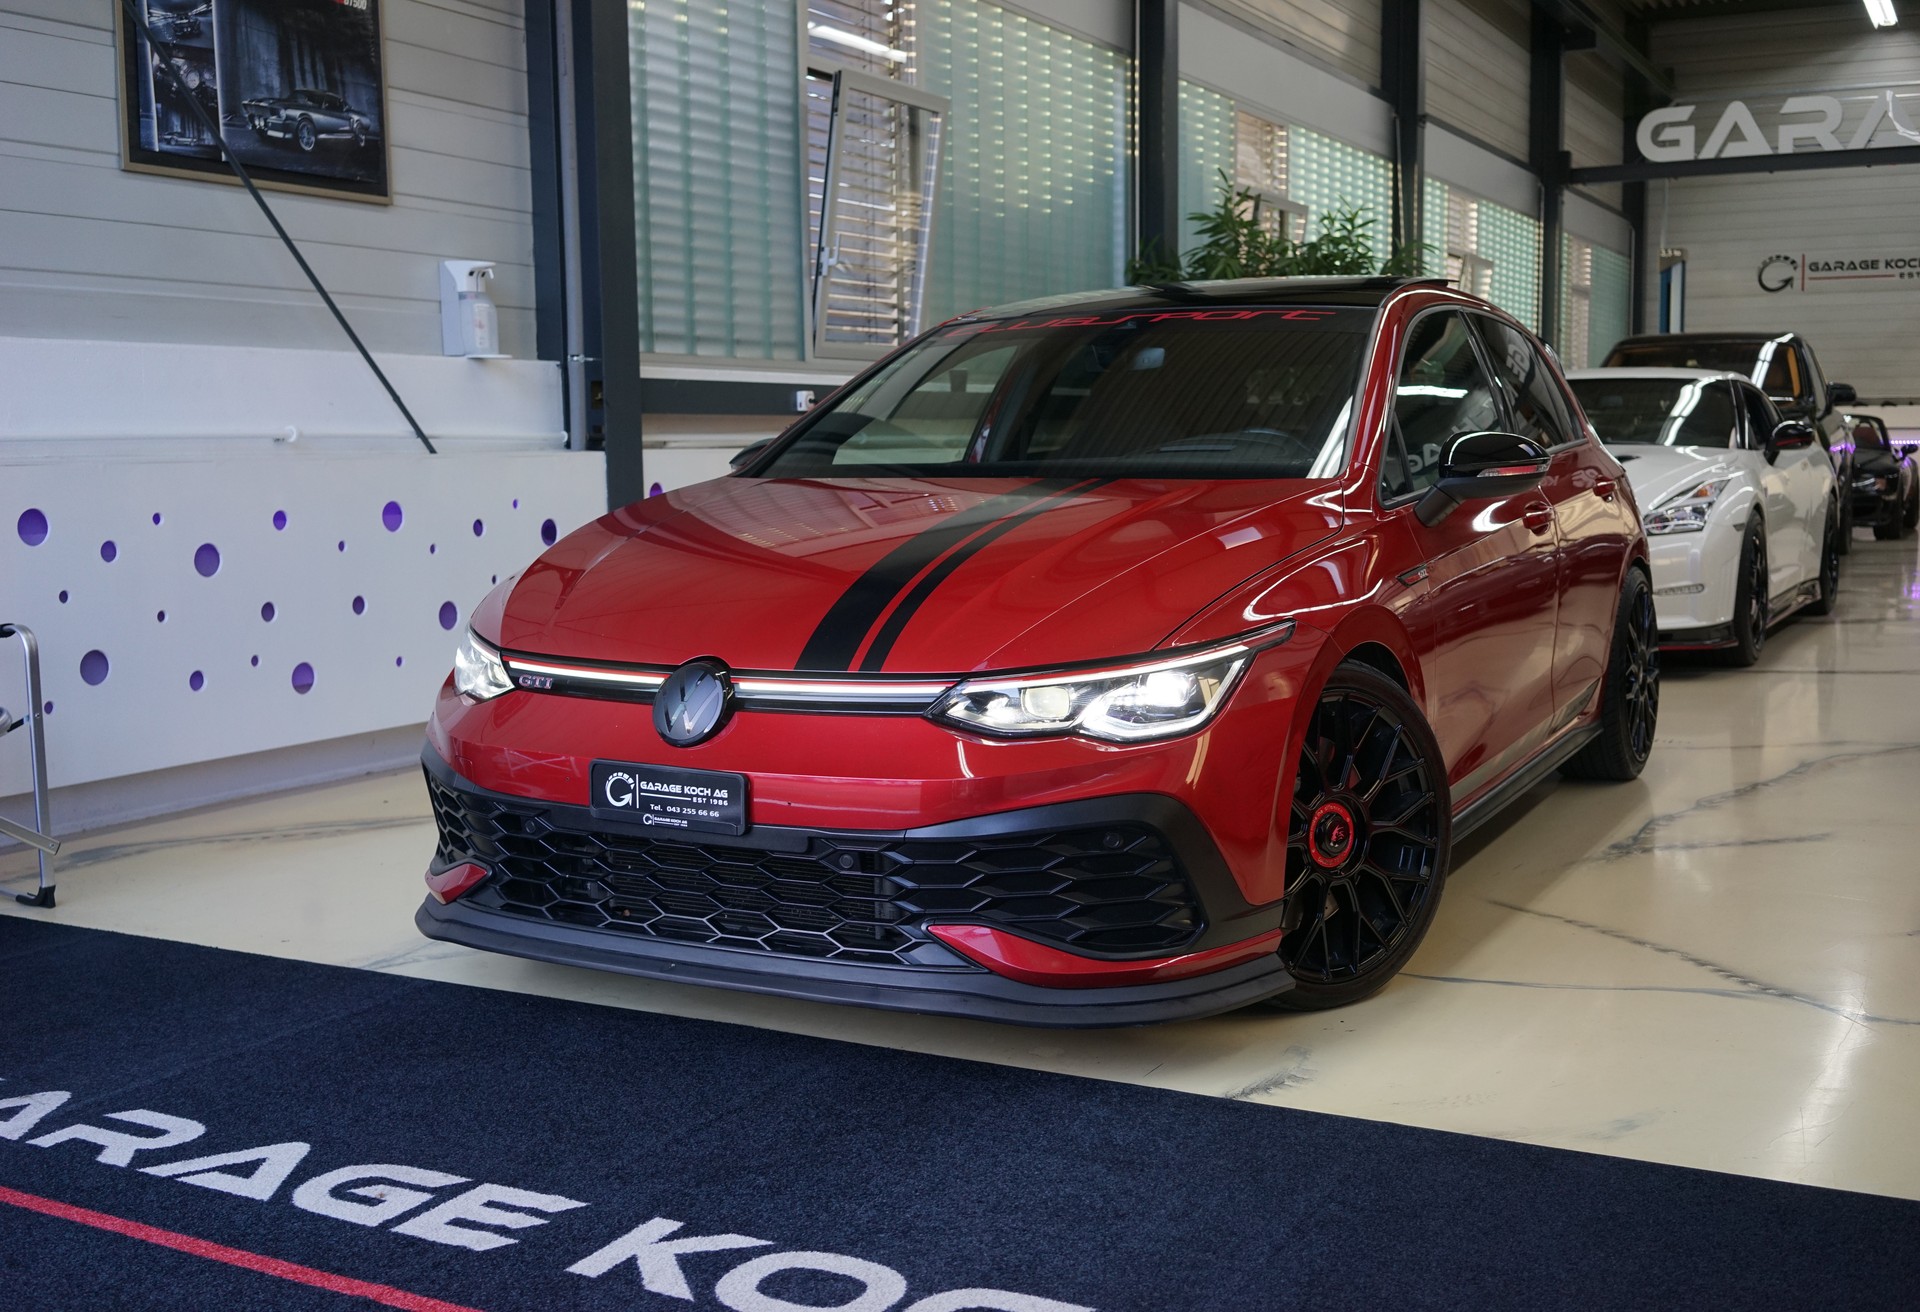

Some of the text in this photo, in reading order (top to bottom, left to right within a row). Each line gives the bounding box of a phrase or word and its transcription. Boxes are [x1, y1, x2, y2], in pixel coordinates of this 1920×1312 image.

[1808, 257, 1920, 272] GARAGE KOC
[518, 674, 553, 689] GTI
[640, 781, 728, 798] GARAGE KOCH AG
[666, 805, 681, 813] 043
[0, 1078, 1099, 1312] ARAGE KO
